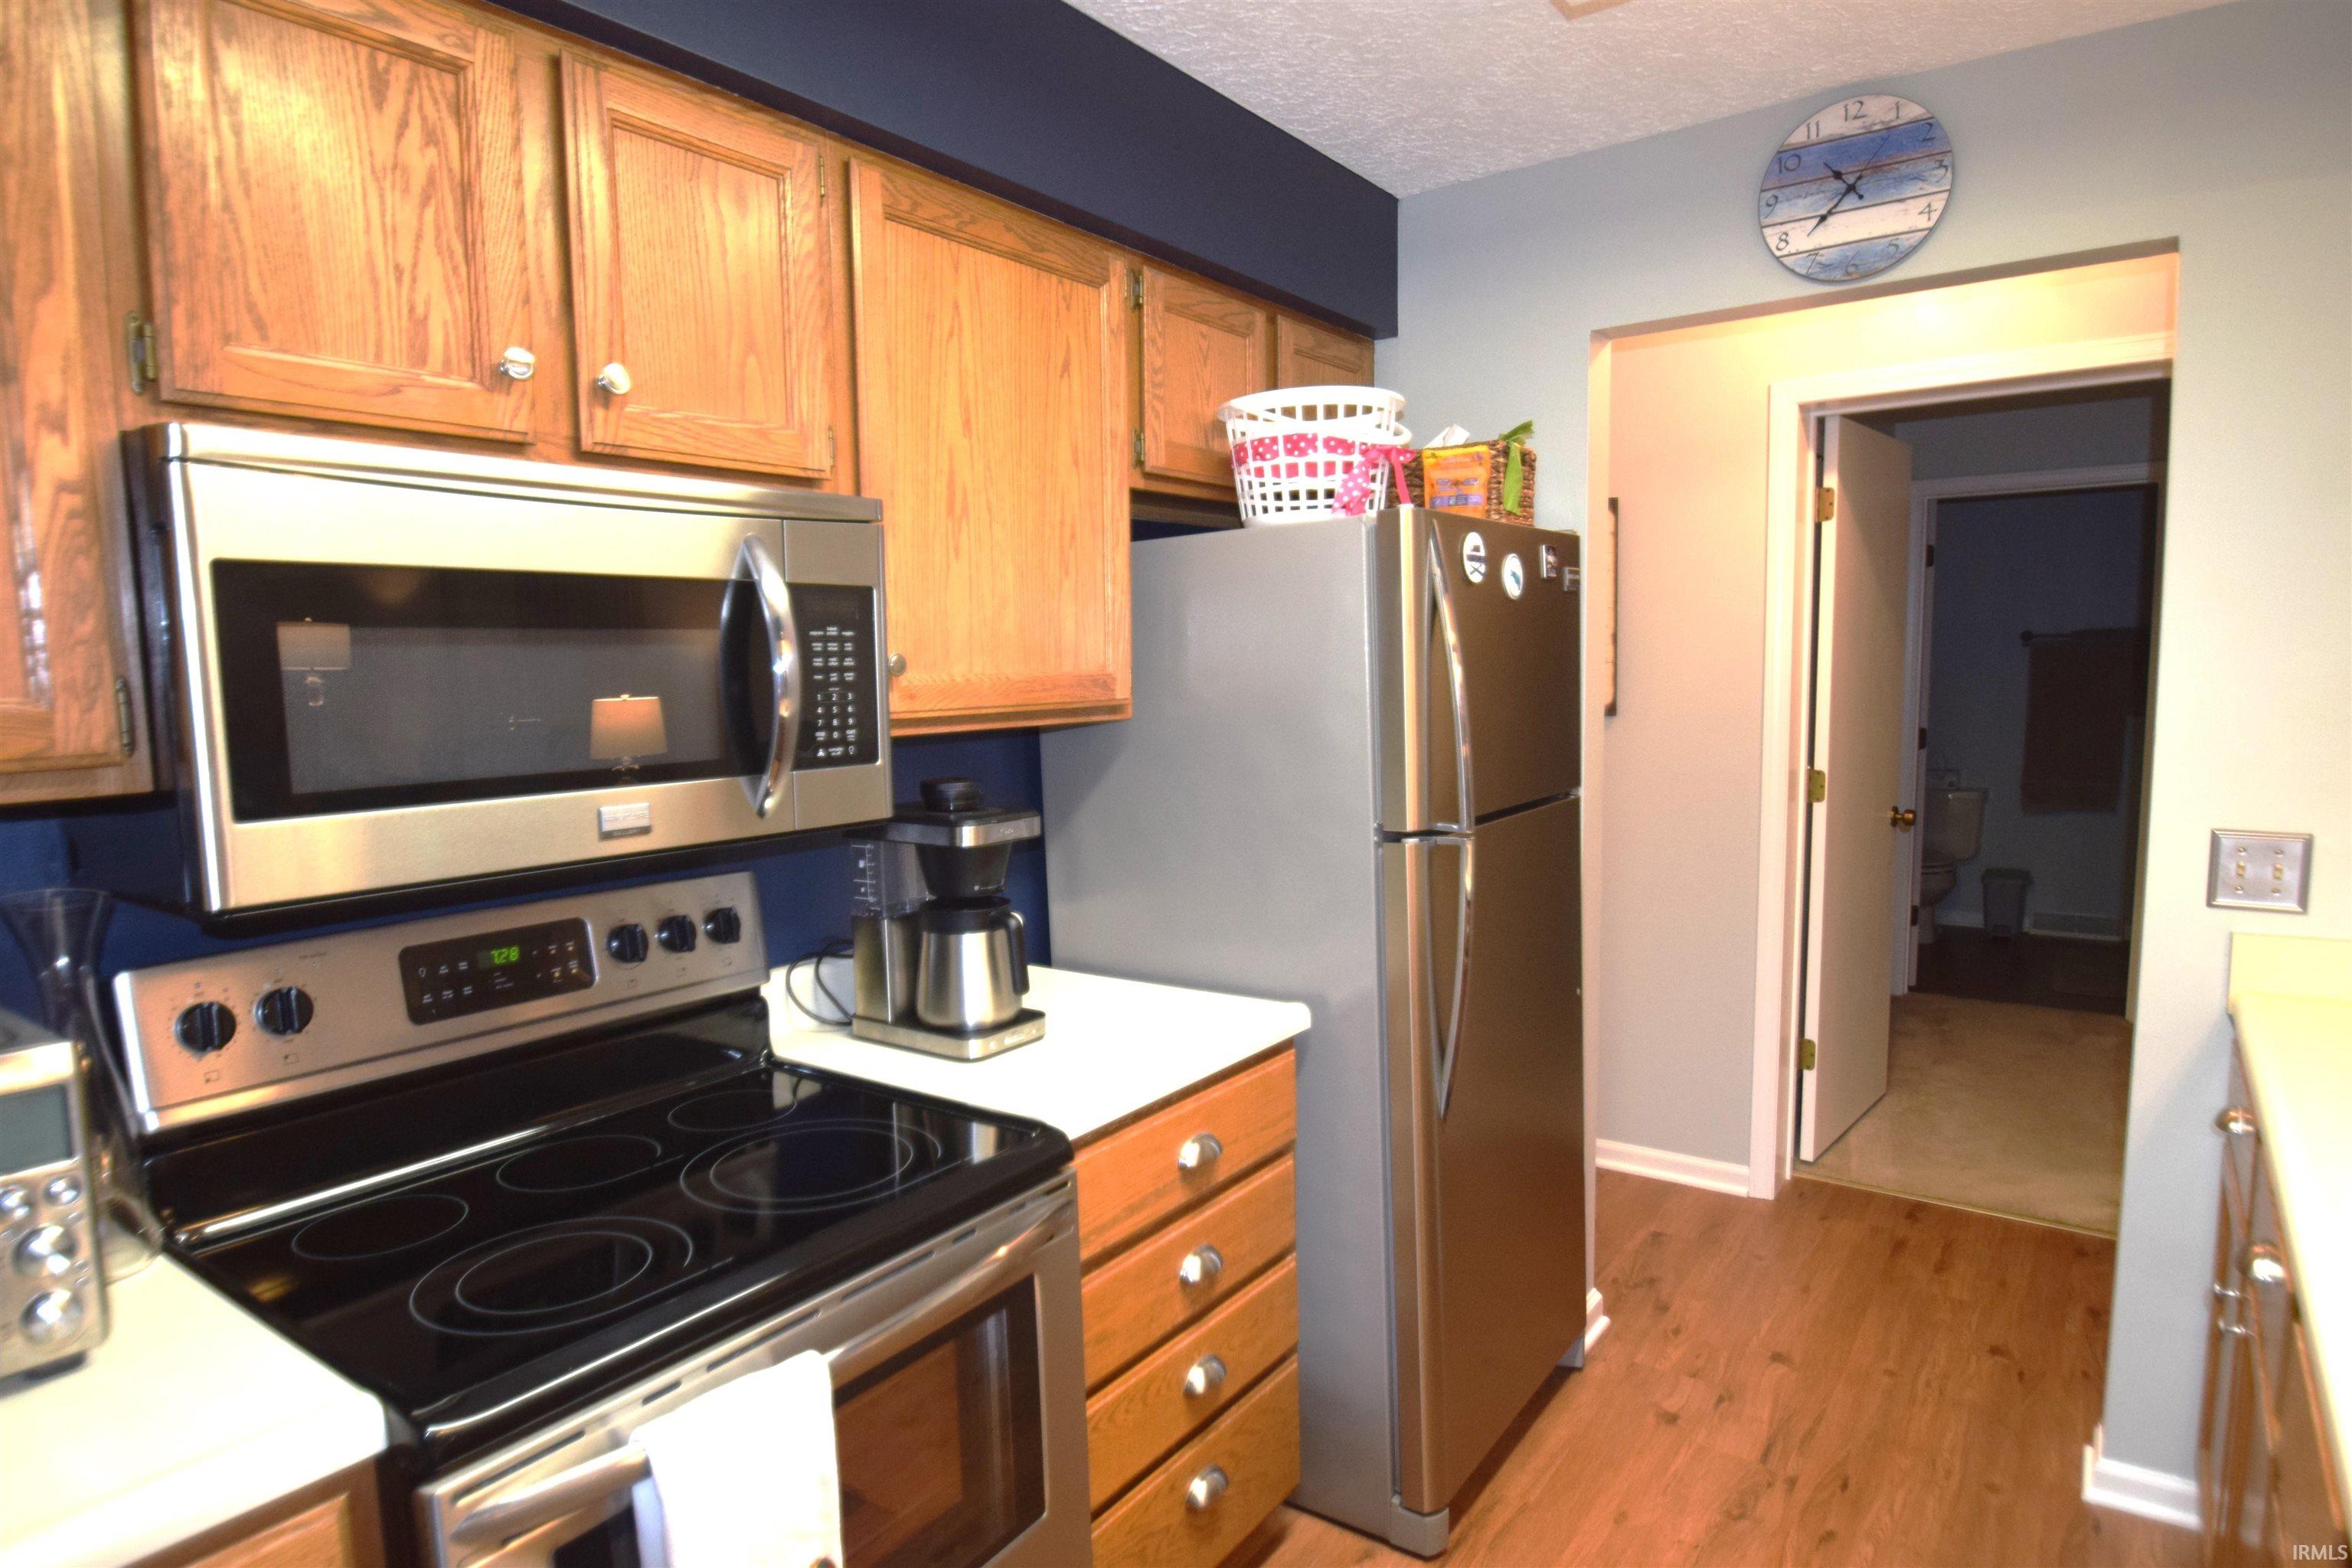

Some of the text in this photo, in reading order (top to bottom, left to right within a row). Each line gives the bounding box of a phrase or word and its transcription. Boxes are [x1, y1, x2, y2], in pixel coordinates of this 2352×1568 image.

[1843, 100, 1867, 122] 12
[1894, 100, 1902, 121] 1
[1806, 120, 1820, 140] 11
[1920, 122, 1936, 142] 2
[1777, 153, 1802, 174] 10
[1935, 159, 1949, 184] 3
[1764, 194, 1779, 220] 9
[1918, 201, 1939, 222] 4
[1775, 231, 1790, 252] 8
[1886, 237, 1900, 255] 5
[1805, 251, 1821, 276] 7
[1845, 250, 1861, 276] 6
